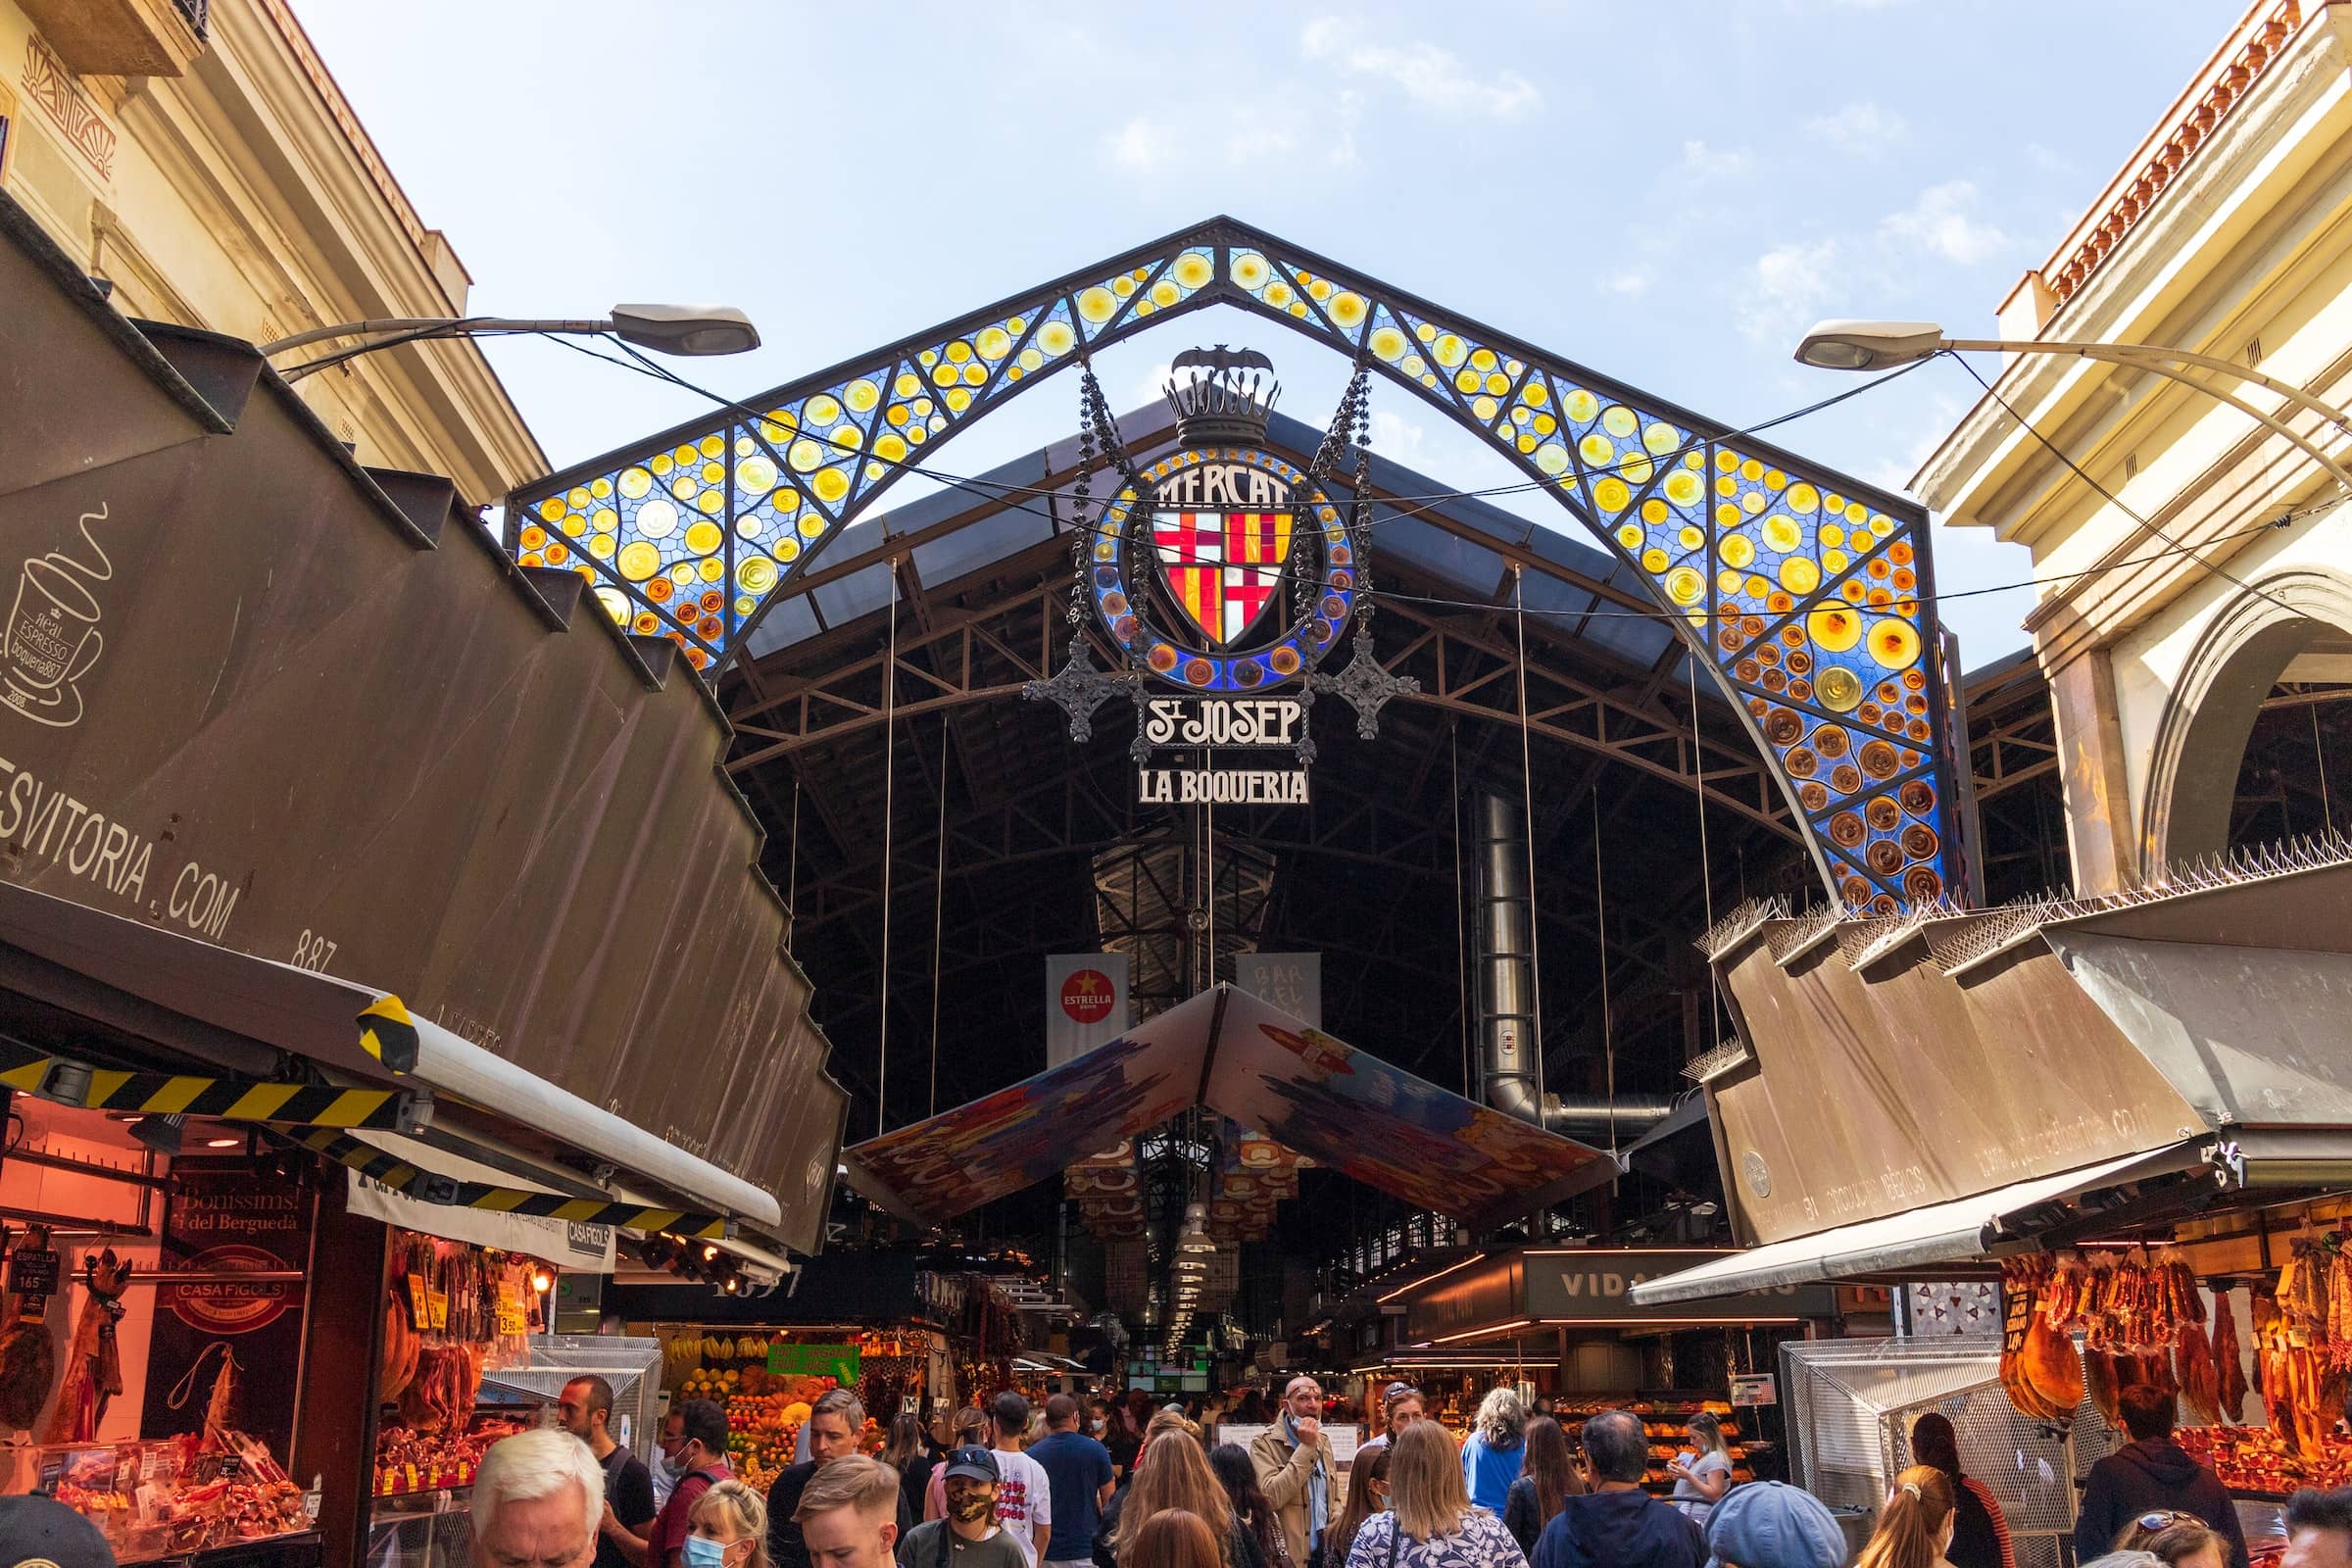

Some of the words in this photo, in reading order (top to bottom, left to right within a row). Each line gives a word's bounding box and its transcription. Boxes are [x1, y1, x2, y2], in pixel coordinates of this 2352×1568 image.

[1154, 465, 1289, 509] MERCAT
[11, 637, 61, 679] boqueria887
[20, 619, 68, 661] ESPRESSO
[1182, 700, 1301, 745] JOSEP
[1140, 770, 1174, 803] LA
[1180, 770, 1309, 804] BOQUERIA
[291, 928, 338, 974] 887
[1064, 994, 1112, 1005] ESTRELLA
[188, 1213, 214, 1230] del
[219, 1212, 298, 1235] Berguedà
[180, 1284, 222, 1296] CASA
[1561, 1273, 1660, 1298] VIDA
